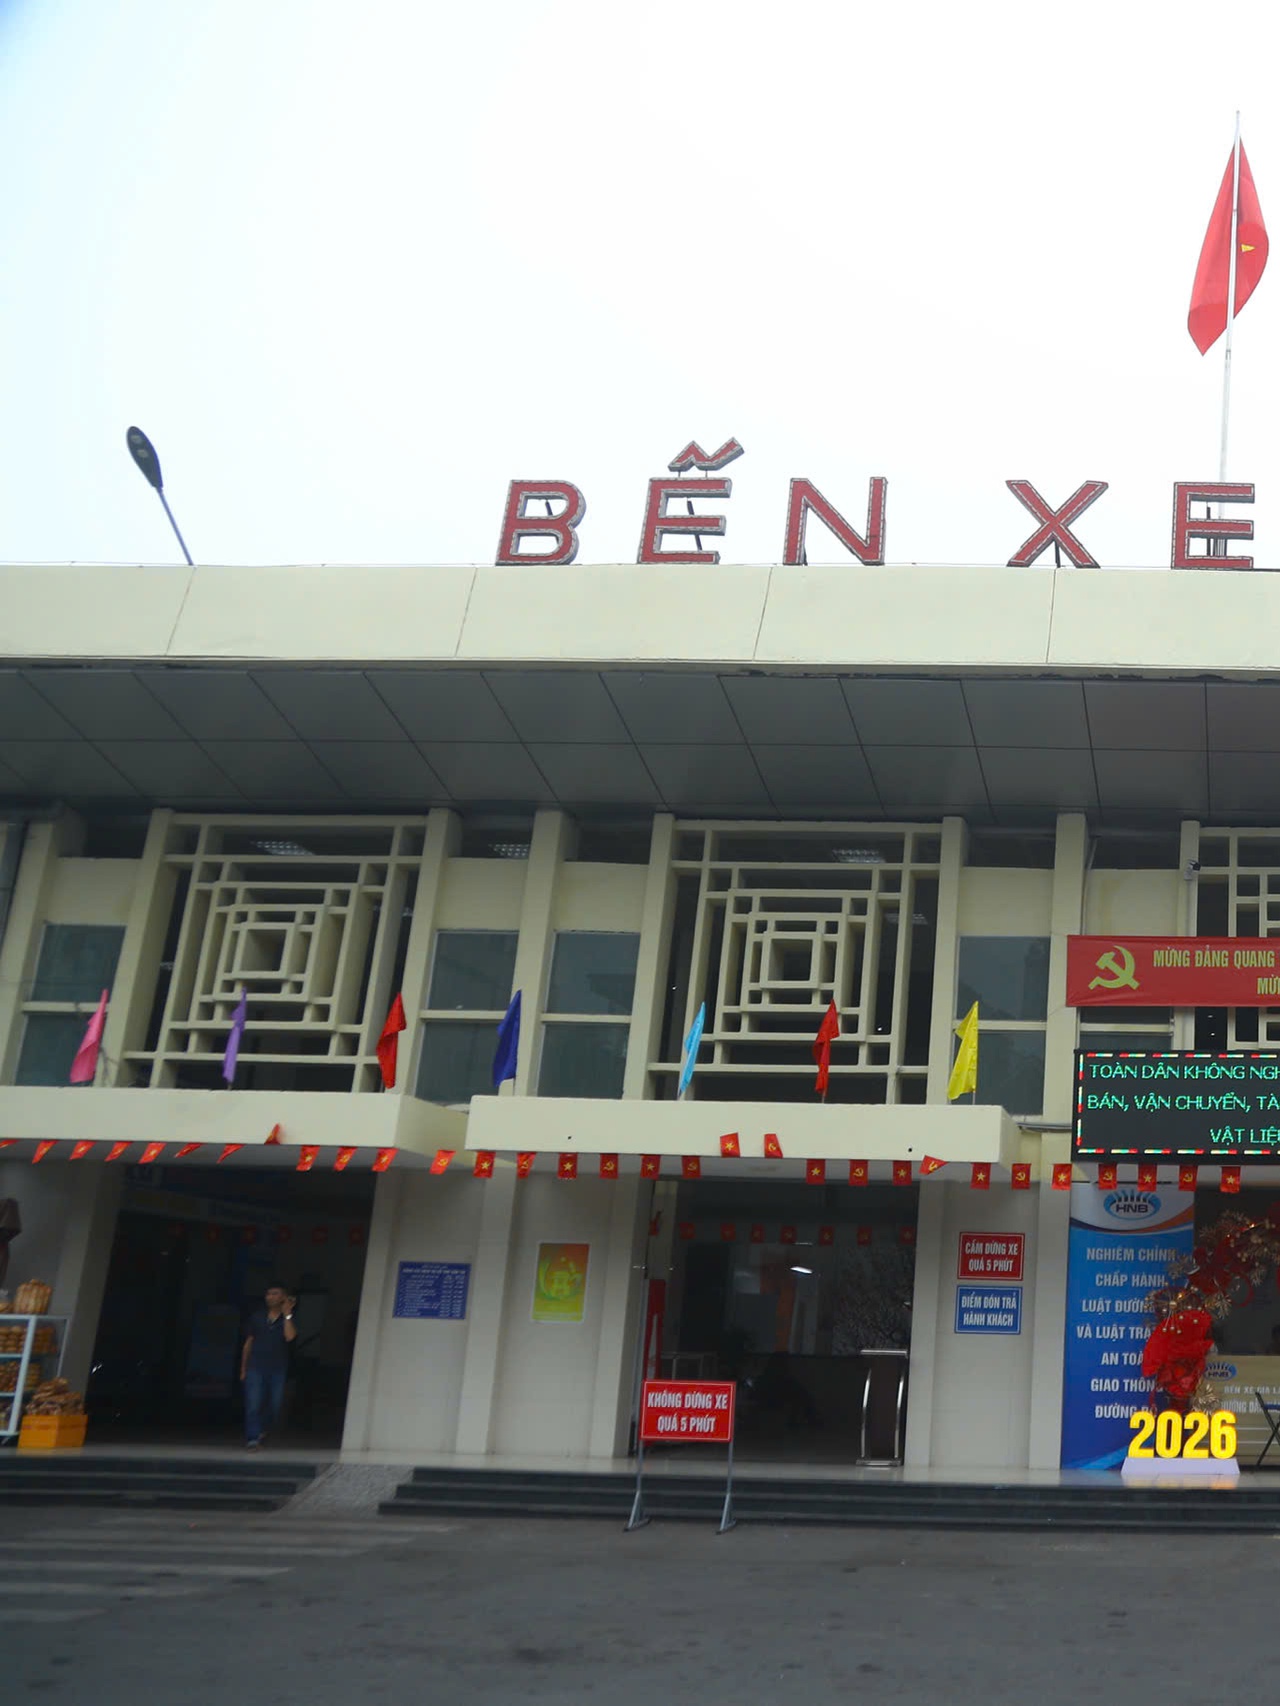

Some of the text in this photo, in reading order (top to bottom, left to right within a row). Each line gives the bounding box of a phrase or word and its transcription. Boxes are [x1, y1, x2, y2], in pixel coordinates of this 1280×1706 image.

[1006, 480, 1255, 569] XE
[1153, 946, 1190, 968] MỪNG
[1195, 944, 1229, 968] ĐẢNG
[1234, 949, 1275, 969] QUANG
[1089, 1062, 1137, 1080] TOÀN
[1142, 1062, 1180, 1080] DÂN
[1184, 1062, 1245, 1080] KHÔNG
[1087, 1092, 1130, 1112] BÁN,
[1133, 1092, 1171, 1112] VẬN
[1175, 1091, 1251, 1113] CHUYỂN,
[1210, 1125, 1245, 1146] VẬT
[1115, 1204, 1149, 1213] HNB
[965, 1238, 1018, 1255] CẤM DỪNG XE
[1087, 1246, 1135, 1262] NGHIÊM
[968, 1257, 1014, 1272] QUÁ 5 PHÚT
[1095, 1270, 1165, 1288] CHẤP HÀNH
[961, 1291, 1017, 1309] ĐIỂM ĐÓN TRẢ
[1082, 1298, 1112, 1315] LUẬT
[963, 1310, 1013, 1327] HÀNH KHÁCH
[1076, 1324, 1092, 1339] VÀ
[1095, 1325, 1126, 1342] LUẬT
[1101, 1352, 1119, 1366] AN
[1090, 1379, 1119, 1392] GIAO
[647, 1389, 728, 1410] KHÔNG DỪNG XE
[657, 1413, 716, 1433] QUÁ 5 PHÚT
[1128, 1410, 1237, 1459] 2026
